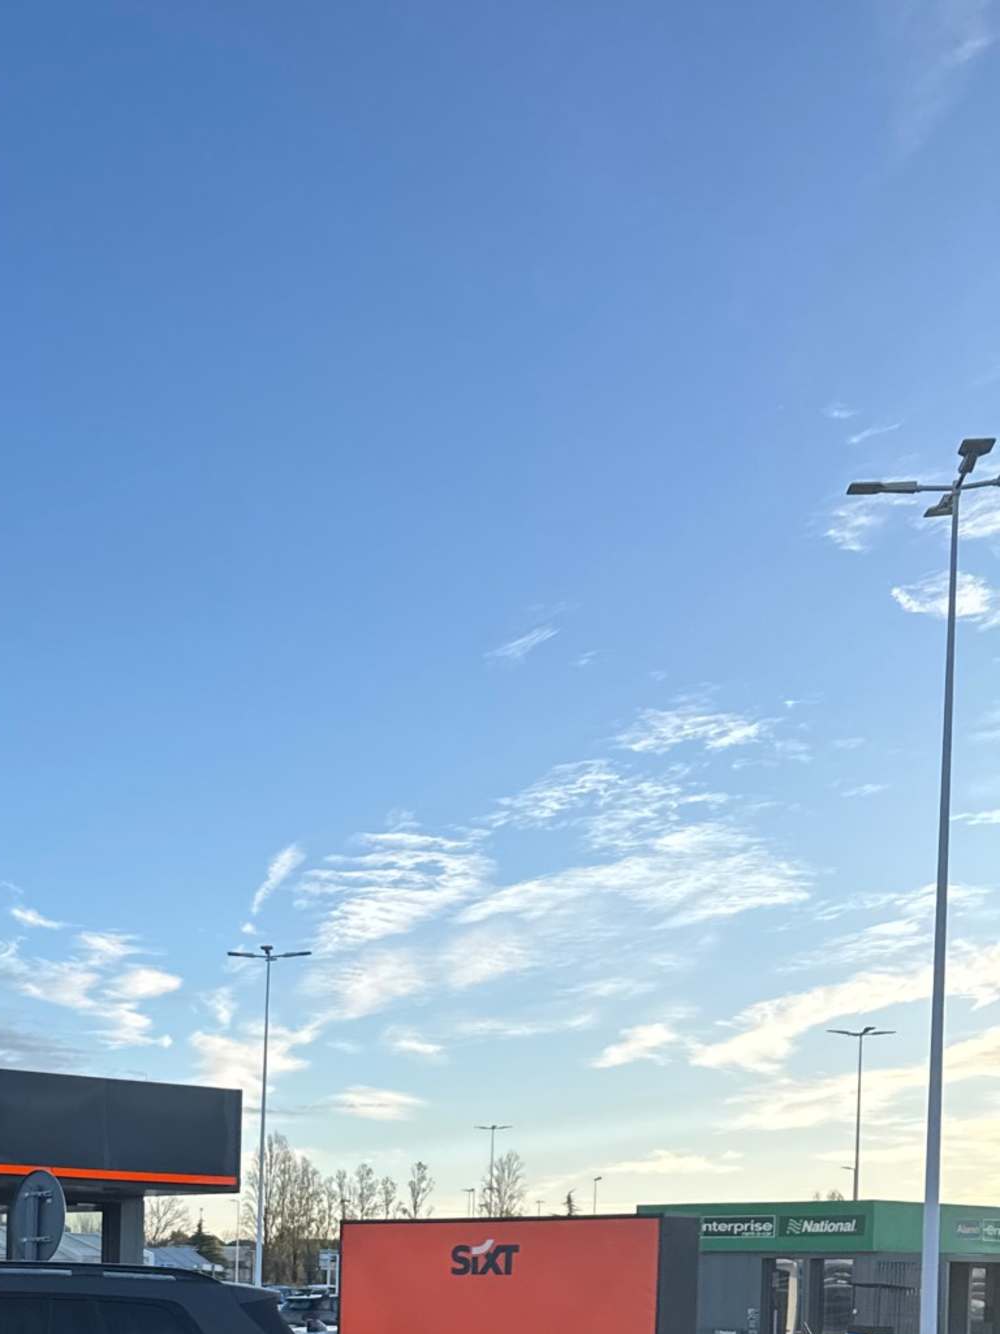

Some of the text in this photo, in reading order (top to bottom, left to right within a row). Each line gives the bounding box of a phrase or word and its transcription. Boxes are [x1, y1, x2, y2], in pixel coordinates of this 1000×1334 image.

[701, 1219, 773, 1235] nterprise
[801, 1219, 857, 1233] National
[451, 1239, 519, 1275] SIXT
